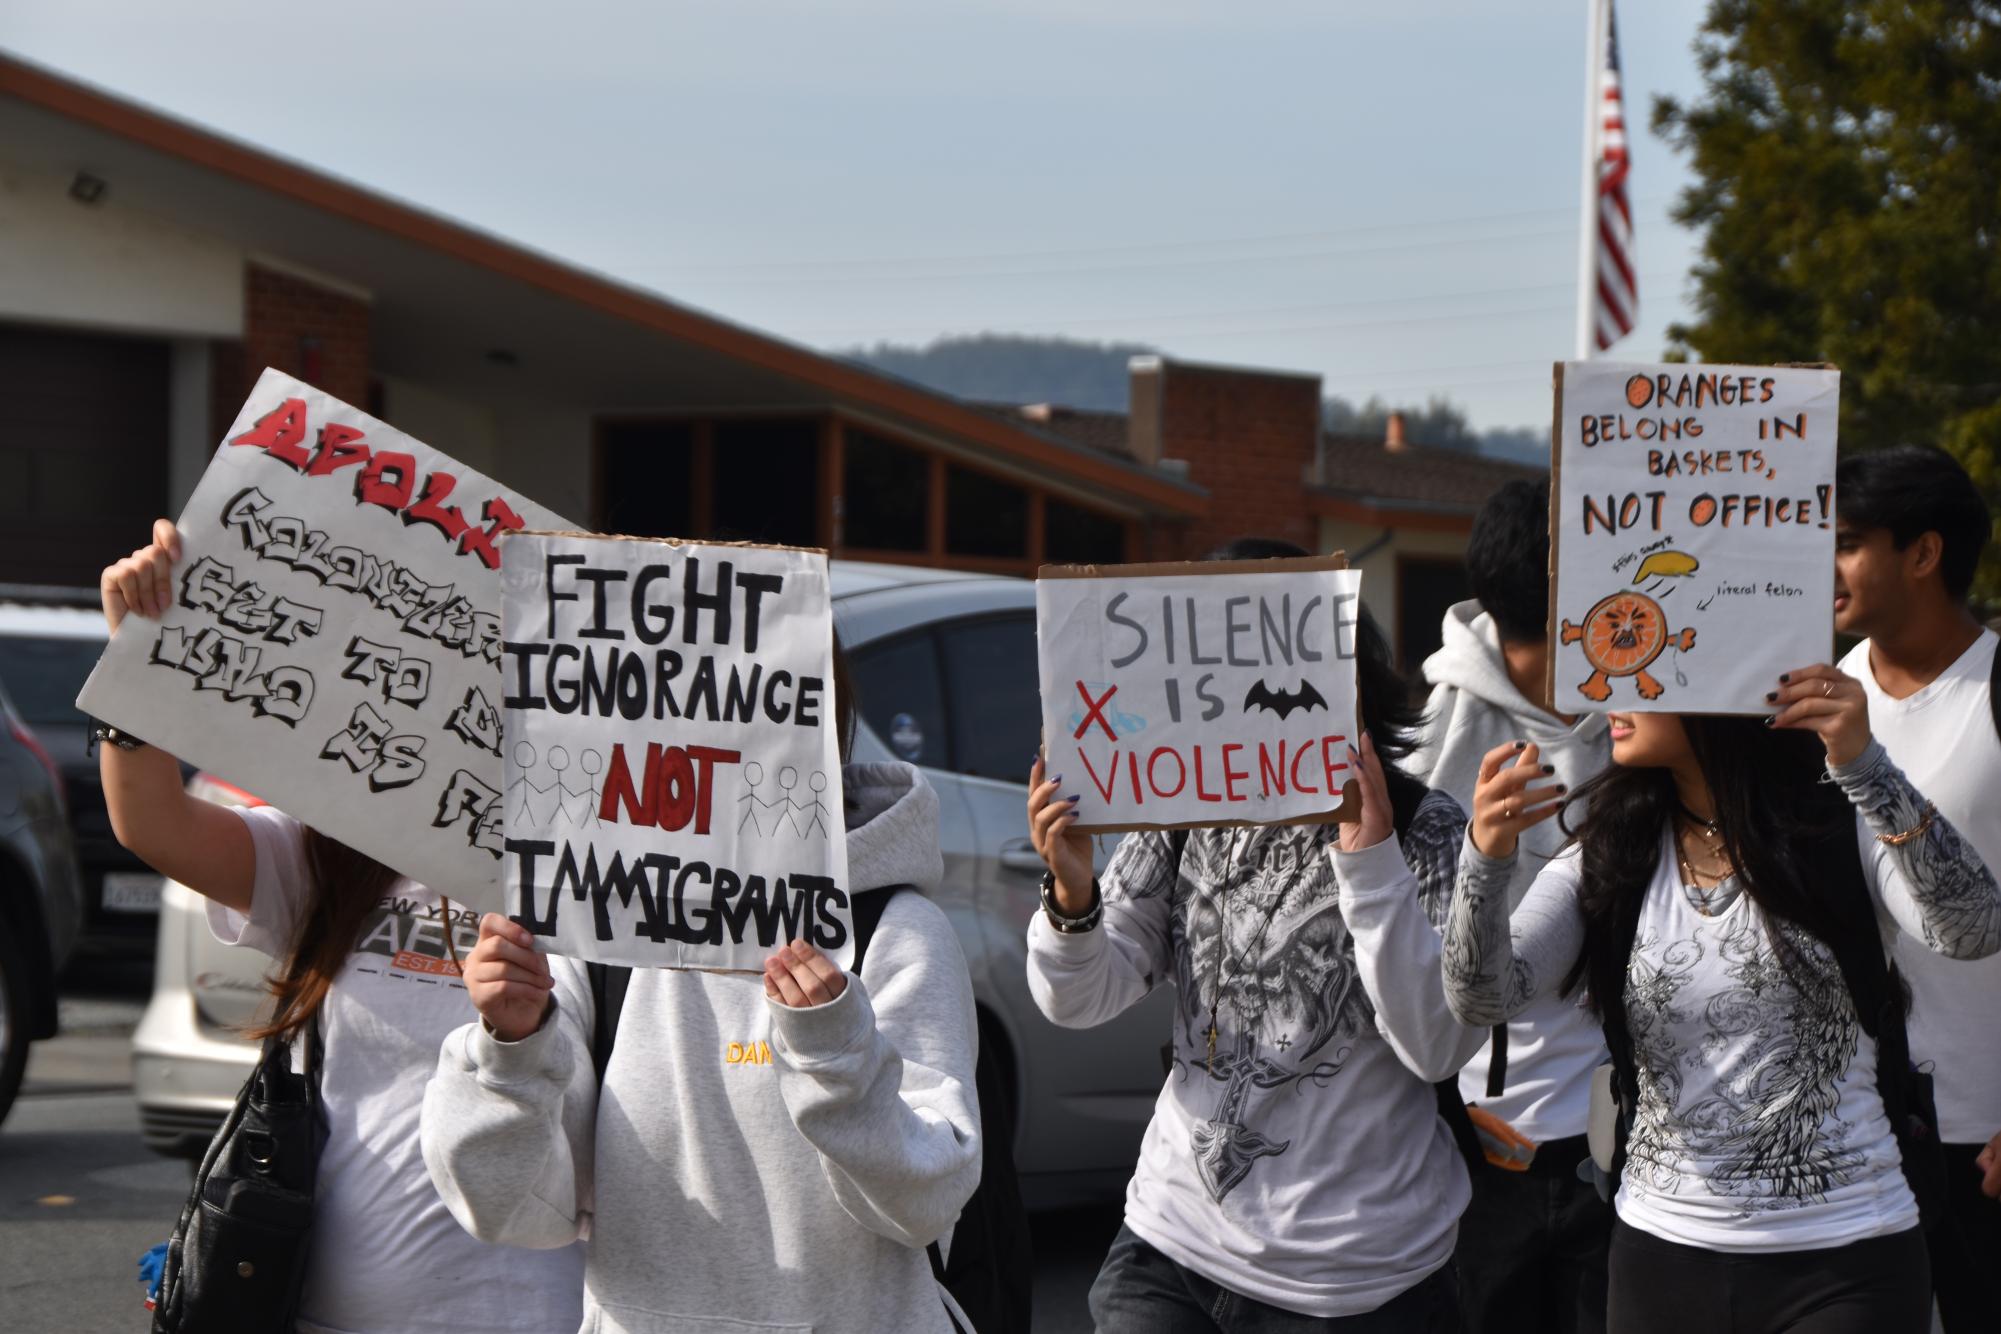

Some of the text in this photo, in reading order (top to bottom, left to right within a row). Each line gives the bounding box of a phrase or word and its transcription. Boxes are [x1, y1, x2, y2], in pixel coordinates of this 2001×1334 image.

[1625, 372, 1776, 409] ORANGES
[1580, 412, 1807, 447] BELONG IN
[1647, 449, 1777, 480] BASKETS,
[1582, 484, 1832, 536] NOT OFFICE!
[546, 554, 784, 654] FIGHT
[1717, 580, 1804, 597] literal felon
[179, 555, 324, 647] GET
[342, 636, 432, 709] TO
[1105, 591, 1357, 669] SILENCE
[149, 626, 316, 729] WHO
[320, 700, 427, 793] IS
[502, 641, 825, 727] IGNORANCE
[1165, 672, 1226, 724] IS
[599, 741, 742, 836] NOT
[1077, 735, 1349, 805] VIOLENCE
[504, 838, 849, 950] IMMIGRANTS
